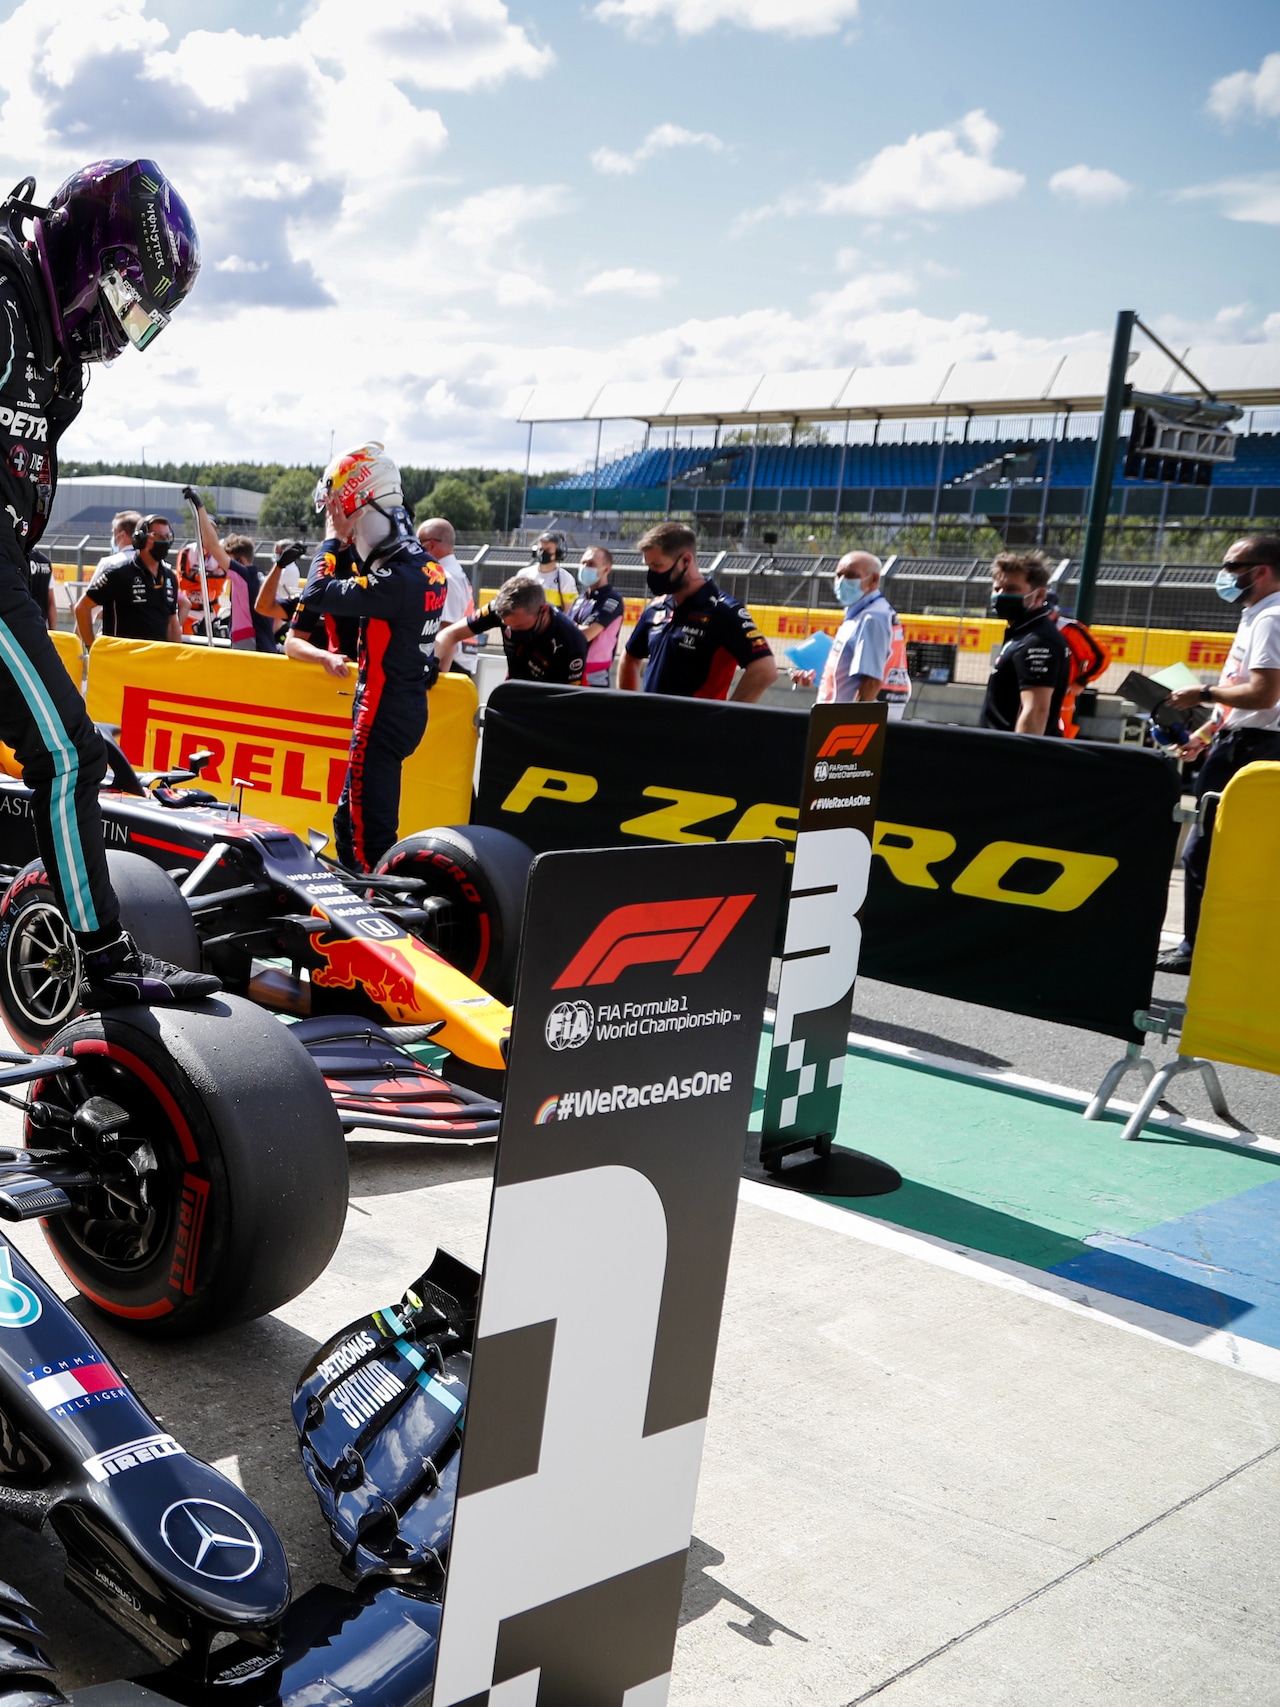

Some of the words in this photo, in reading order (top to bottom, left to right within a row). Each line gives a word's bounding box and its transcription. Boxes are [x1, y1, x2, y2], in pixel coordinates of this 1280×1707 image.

[140, 212, 154, 260] ENERGY
[147, 202, 165, 269] MONSTER
[122, 280, 143, 303] EPSON
[120, 685, 354, 805] PIRELL
[501, 766, 599, 814] P
[817, 795, 871, 810] #WeRaceAsOne
[0, 795, 33, 819] AST
[101, 817, 129, 844] TIN
[414, 849, 482, 903] ZERO
[551, 894, 757, 990] F1
[596, 1020, 636, 1042] World
[639, 1008, 732, 1035] Championship
[597, 1005, 621, 1022] FIA
[623, 998, 680, 1018] Formula
[681, 996, 689, 1011] 1
[557, 1070, 733, 1121] #WeRaceAsOne
[168, 1172, 211, 1296] PIRELLI
[27, 1354, 99, 1382] TOMMY
[317, 1330, 376, 1385] PETRONAS
[55, 1387, 127, 1418] HILFIGER
[328, 1359, 406, 1430] SYNTIUM
[82, 1433, 187, 1483] PIRELLI
